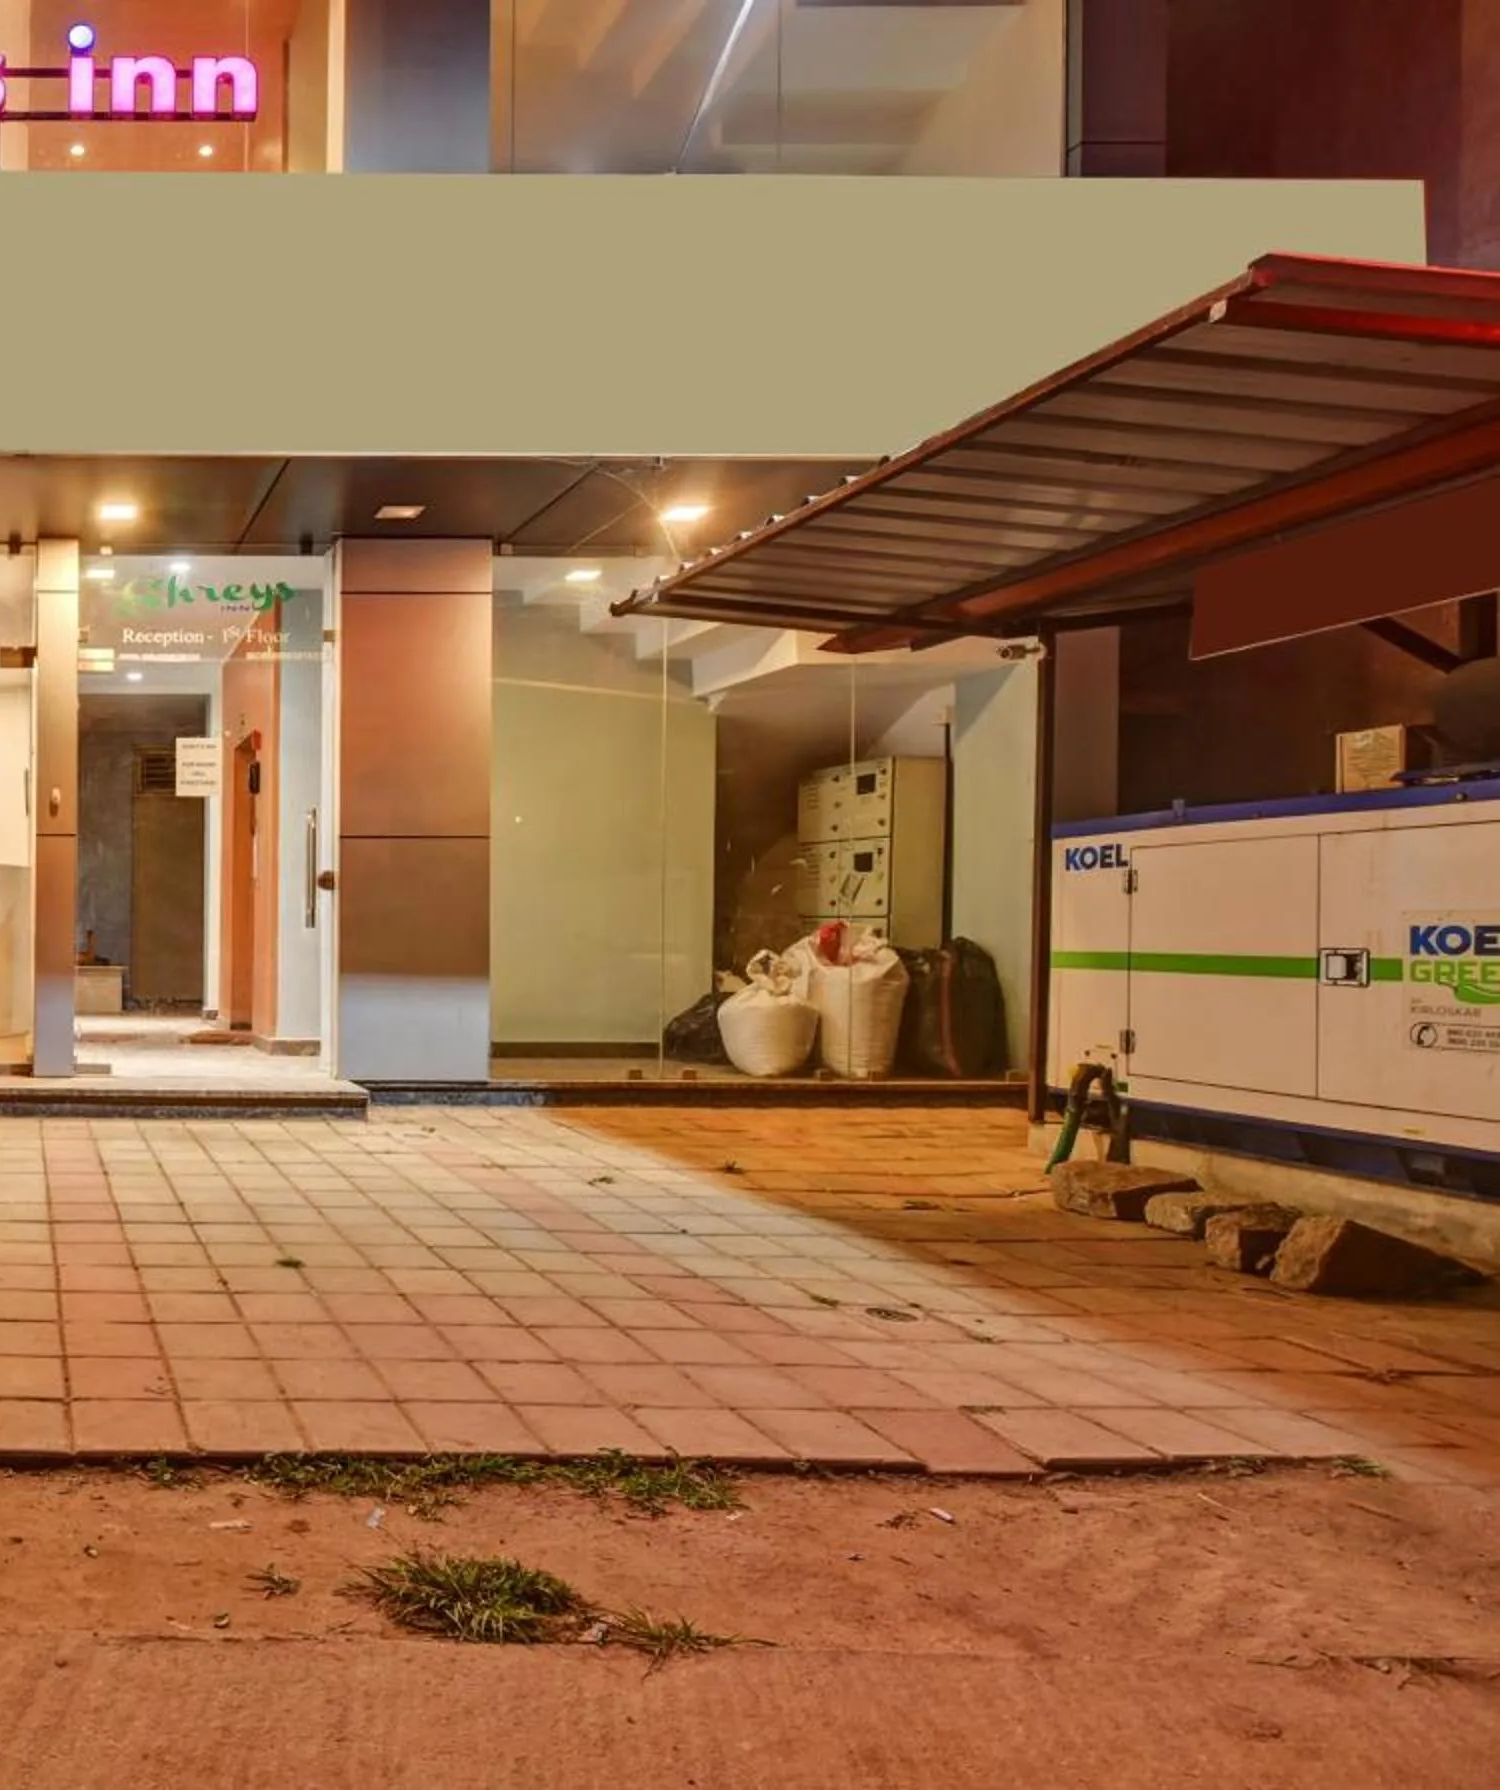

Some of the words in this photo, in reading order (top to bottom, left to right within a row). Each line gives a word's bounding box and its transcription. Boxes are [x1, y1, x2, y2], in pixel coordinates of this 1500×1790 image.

[68, 23, 258, 121] inn
[122, 628, 203, 647] Reception
[246, 629, 291, 645] Floor
[1065, 843, 1129, 872] KOEL
